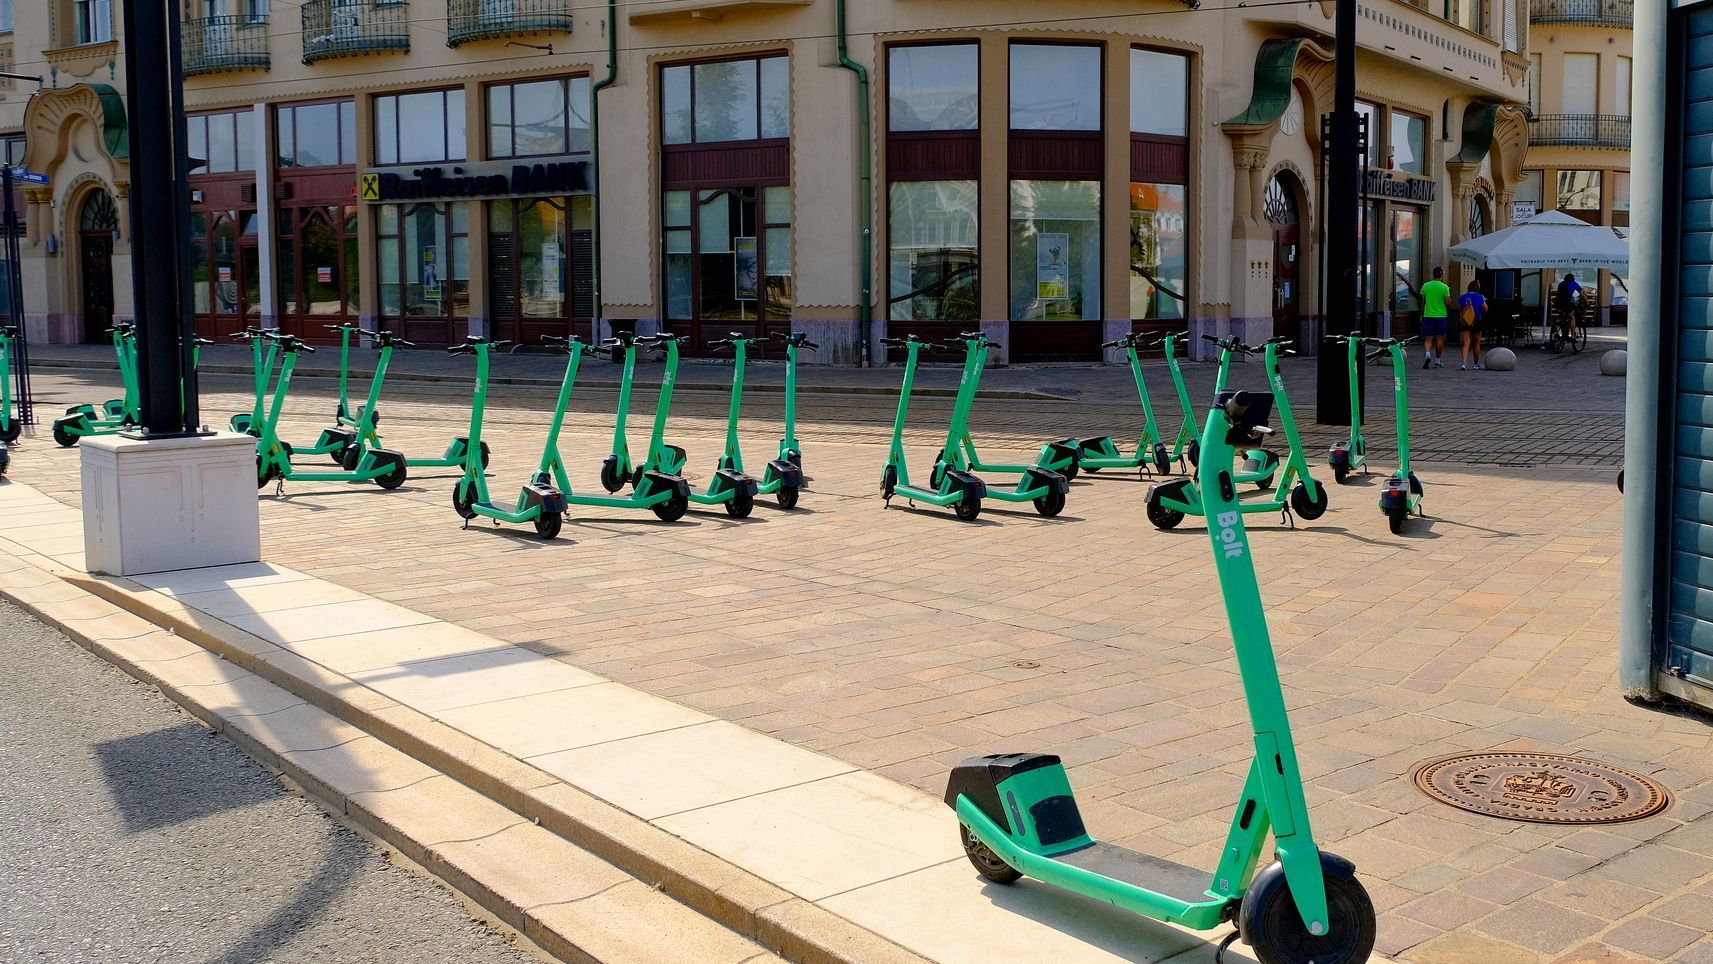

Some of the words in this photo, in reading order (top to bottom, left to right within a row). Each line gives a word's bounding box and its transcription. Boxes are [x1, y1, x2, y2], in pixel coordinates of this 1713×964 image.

[511, 161, 588, 193] BANK
[1360, 170, 1410, 198] aiffeisen
[1411, 178, 1437, 201] BANK
[1274, 375, 1284, 392] Bolt
[1215, 510, 1243, 559] Bolt
